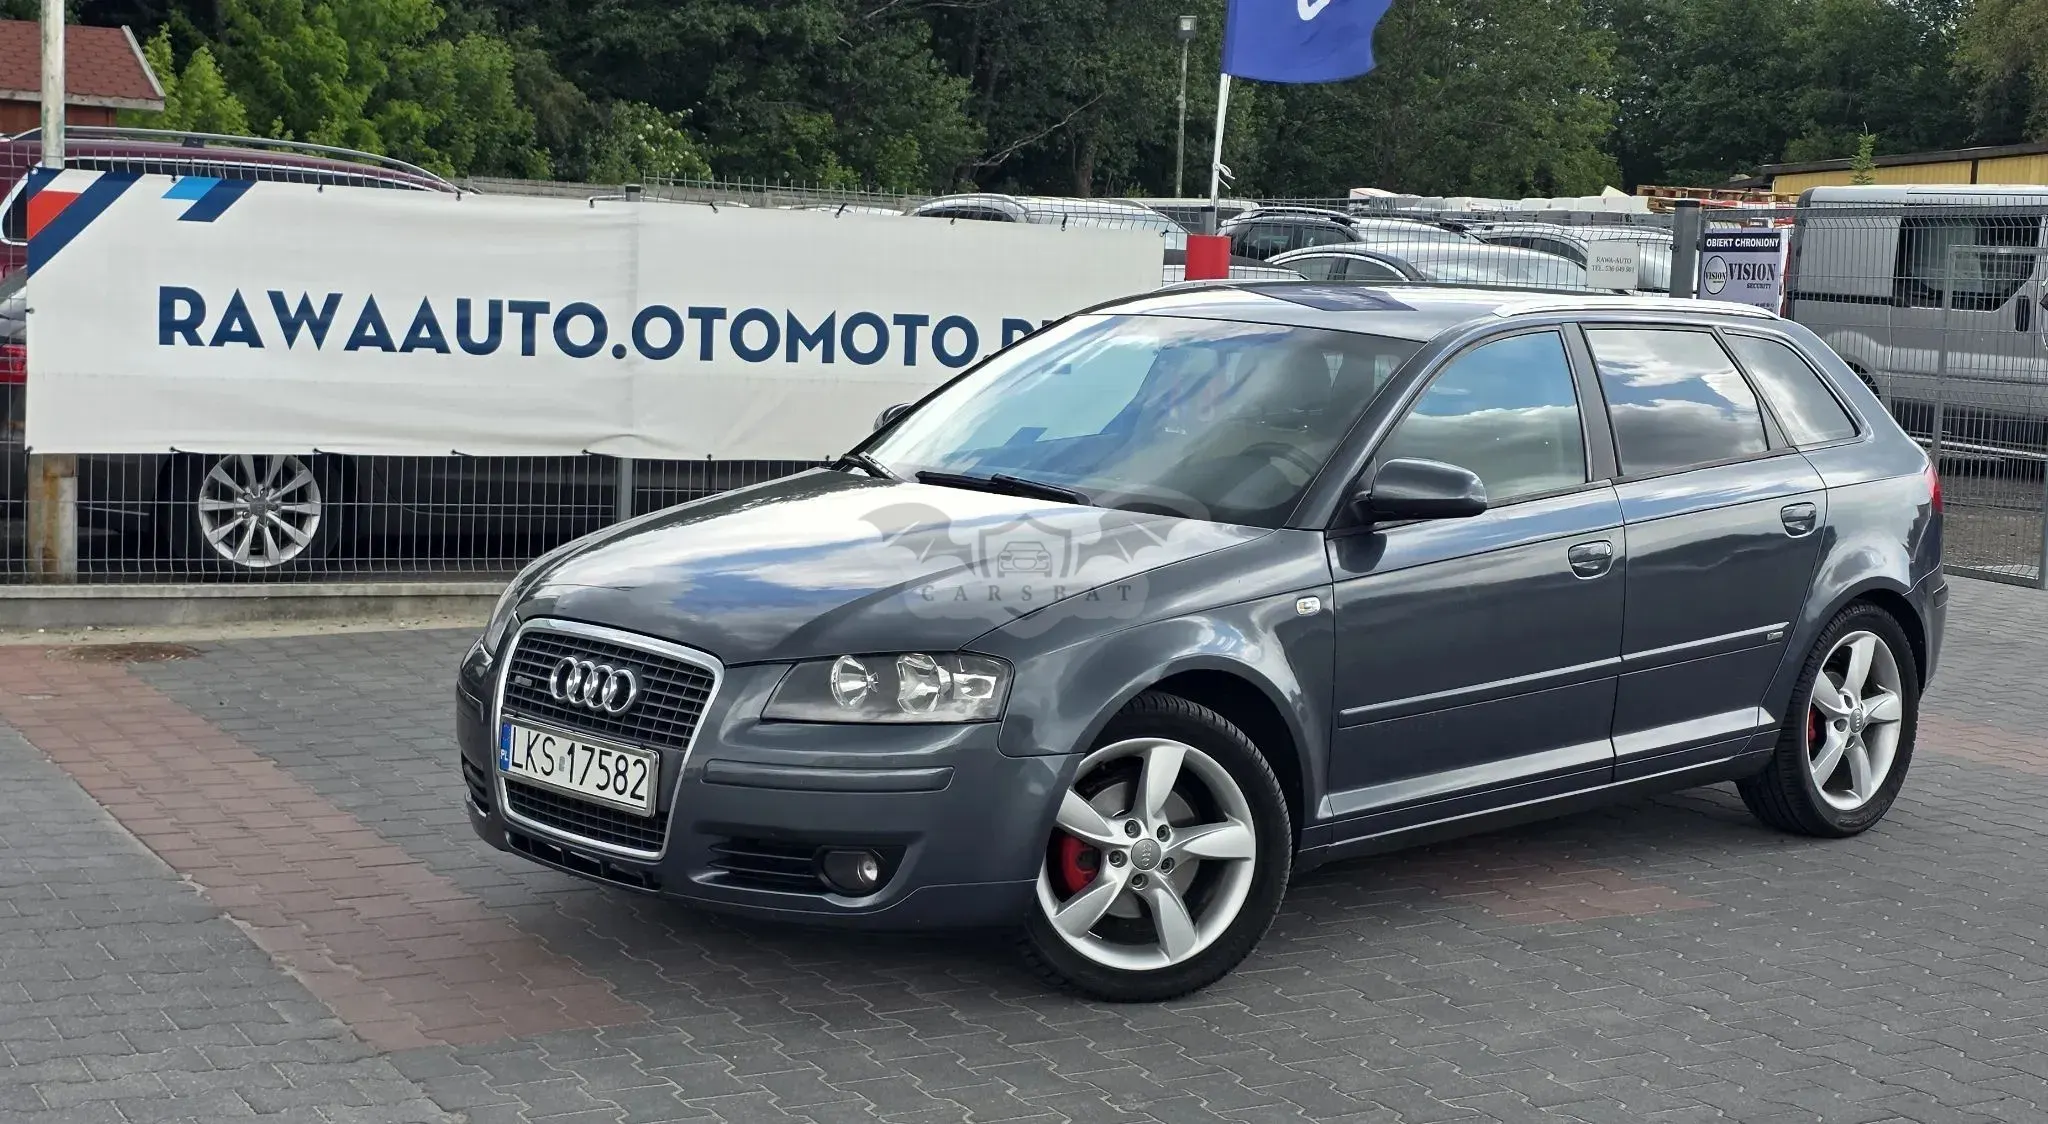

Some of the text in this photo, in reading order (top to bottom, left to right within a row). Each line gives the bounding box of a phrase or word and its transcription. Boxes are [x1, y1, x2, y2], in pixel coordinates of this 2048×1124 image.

[1706, 238, 1780, 247] OBIEKT CHRONIONY
[1596, 256, 1632, 265] RAWA-AUTO
[1705, 272, 1726, 280] VISION
[1728, 263, 1776, 281] VISION
[511, 727, 648, 801] LKS 17582
